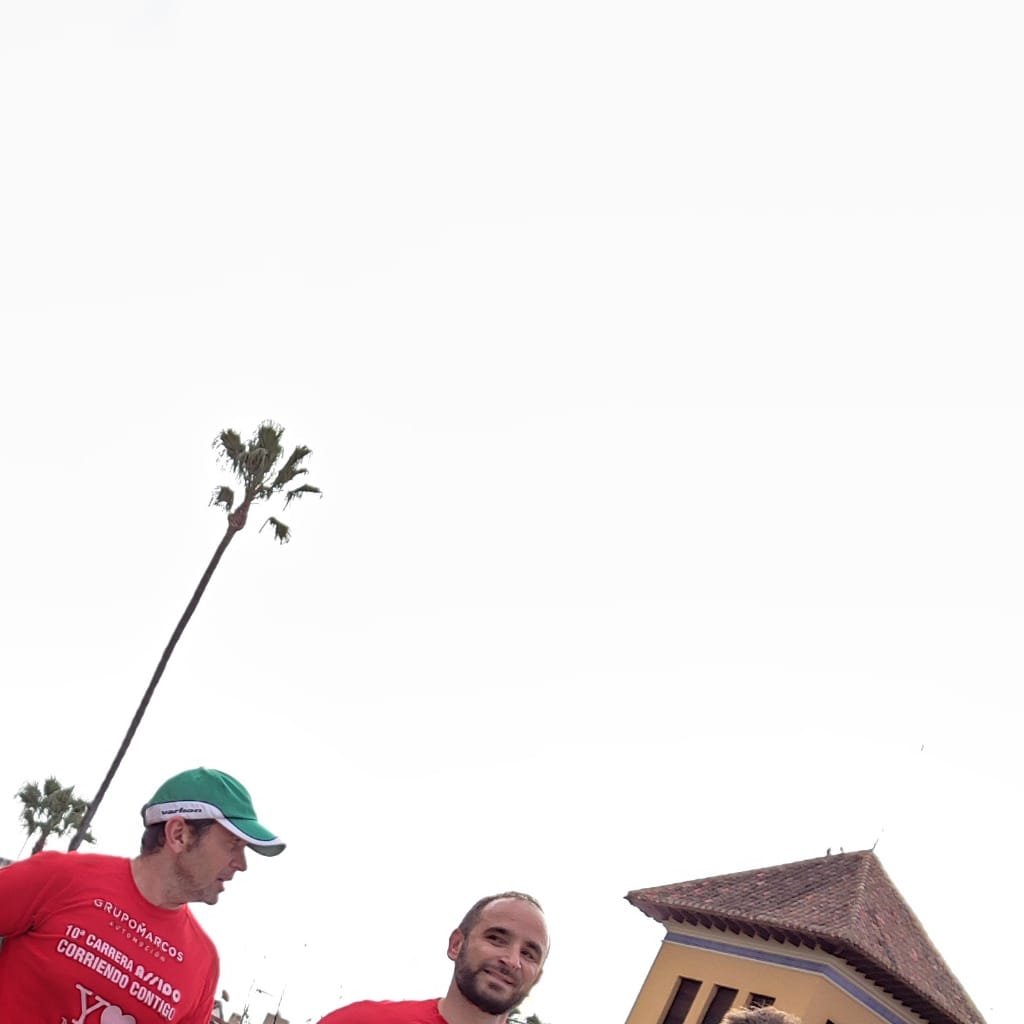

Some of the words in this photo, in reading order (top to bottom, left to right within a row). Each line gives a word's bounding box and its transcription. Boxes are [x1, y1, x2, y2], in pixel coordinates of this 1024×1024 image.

[56, 938, 129, 989] CORRIENDO
[129, 981, 176, 1021] CONTIGO
[85, 934, 134, 972] CARRERA
